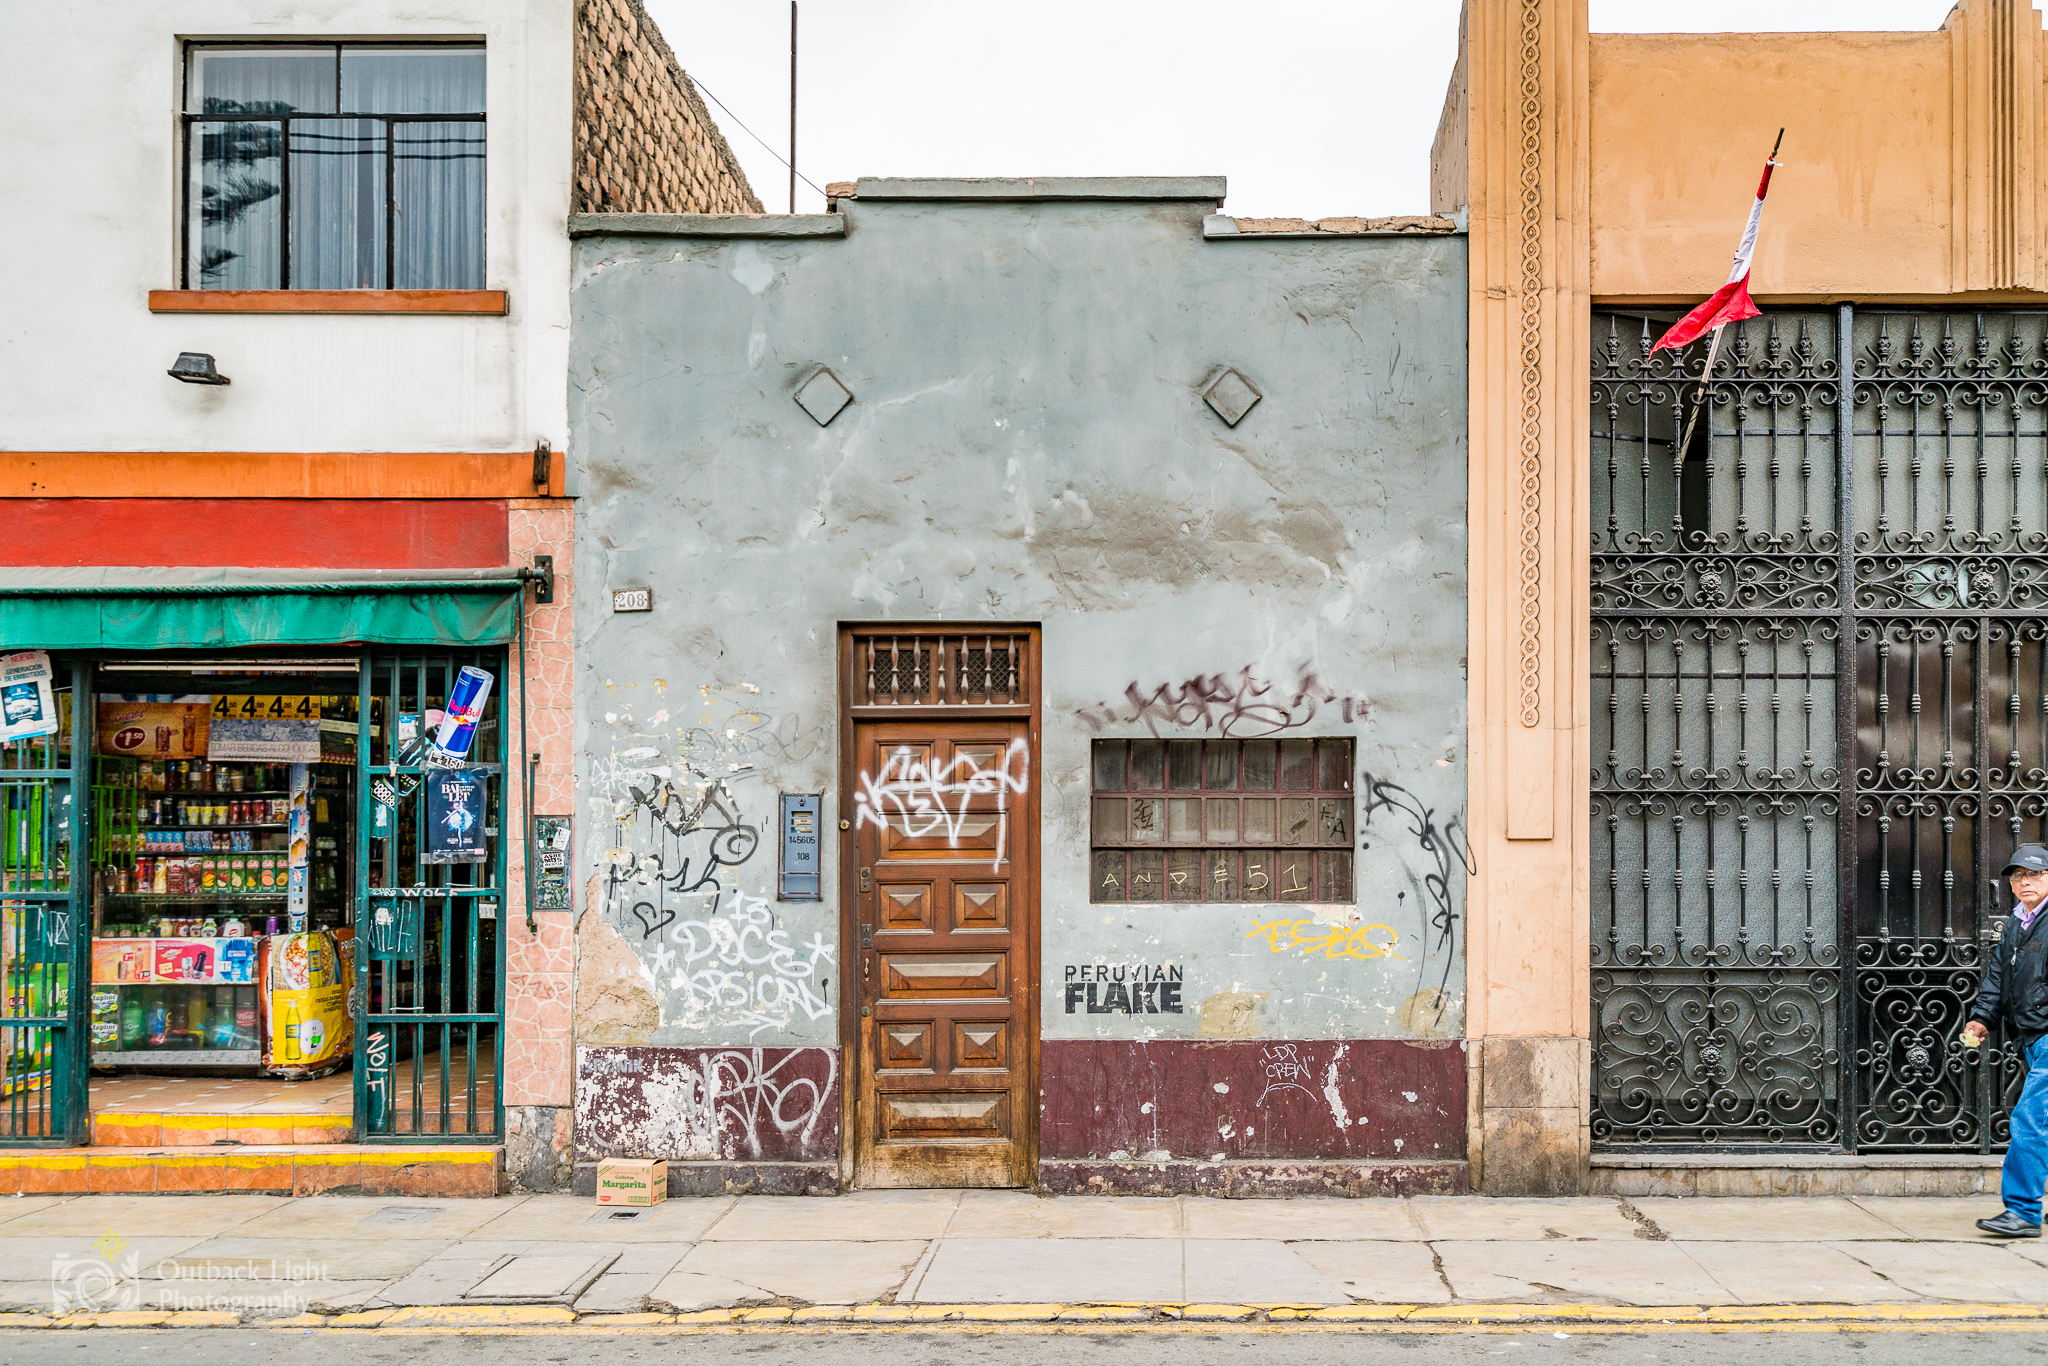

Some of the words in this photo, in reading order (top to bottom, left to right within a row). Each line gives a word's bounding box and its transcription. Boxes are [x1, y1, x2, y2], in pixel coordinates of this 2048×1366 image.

[616, 592, 646, 607] 208
[10, 653, 35, 663] NUEVA
[450, 698, 466, 715] Red
[788, 835, 816, 844] 145605
[797, 852, 810, 860] 108
[1065, 964, 1183, 982] PERUVIAN
[1065, 982, 1184, 1014] FLAKE
[602, 1180, 647, 1189] Margarita
